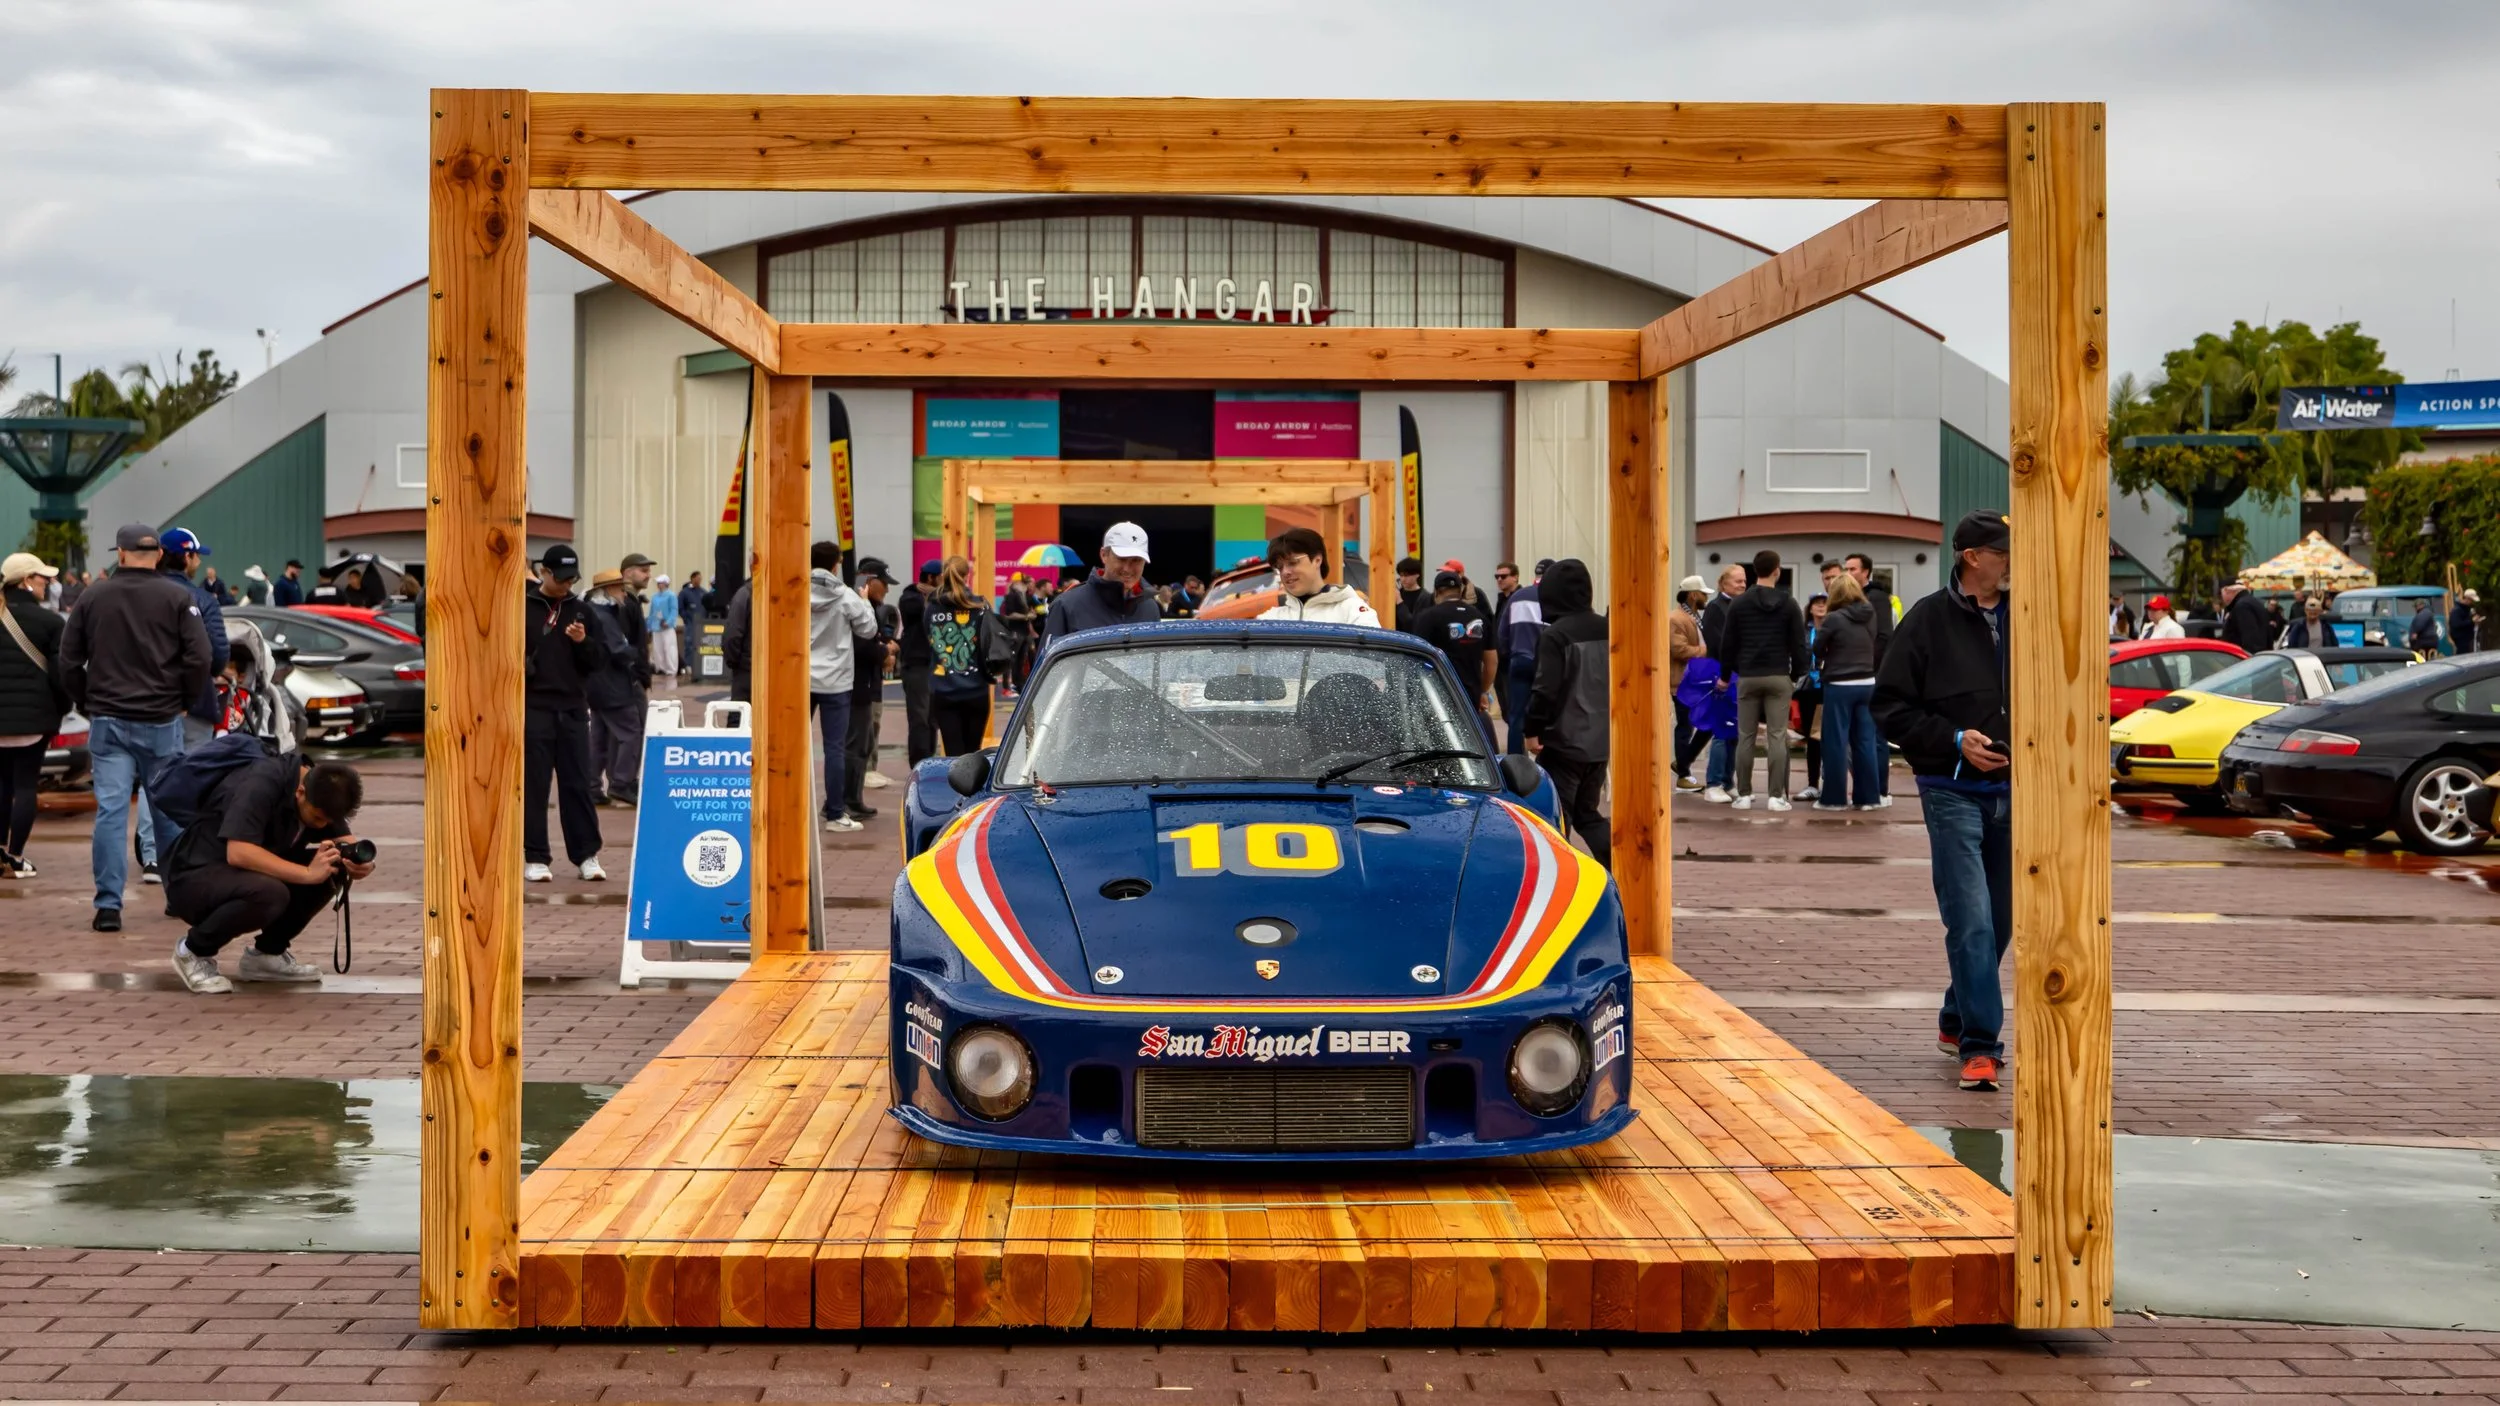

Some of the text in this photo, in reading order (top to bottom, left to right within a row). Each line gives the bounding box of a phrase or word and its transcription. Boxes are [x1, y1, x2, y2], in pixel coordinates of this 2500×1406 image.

[950, 275, 1314, 324] THE HANGAR
[2420, 398, 2473, 412] ACTION
[1235, 422, 1271, 430] BROAD
[1274, 422, 1311, 430] ARROW
[668, 777, 699, 786] SCAN
[701, 777, 718, 787] QR
[674, 800, 703, 810] VOTE
[705, 800, 728, 810] FOR
[691, 813, 743, 822] FAVORITE
[1168, 821, 1340, 871] 10
[905, 1001, 943, 1032] GOODYEAR
[1138, 1024, 1412, 1063] San Miguel BEER
